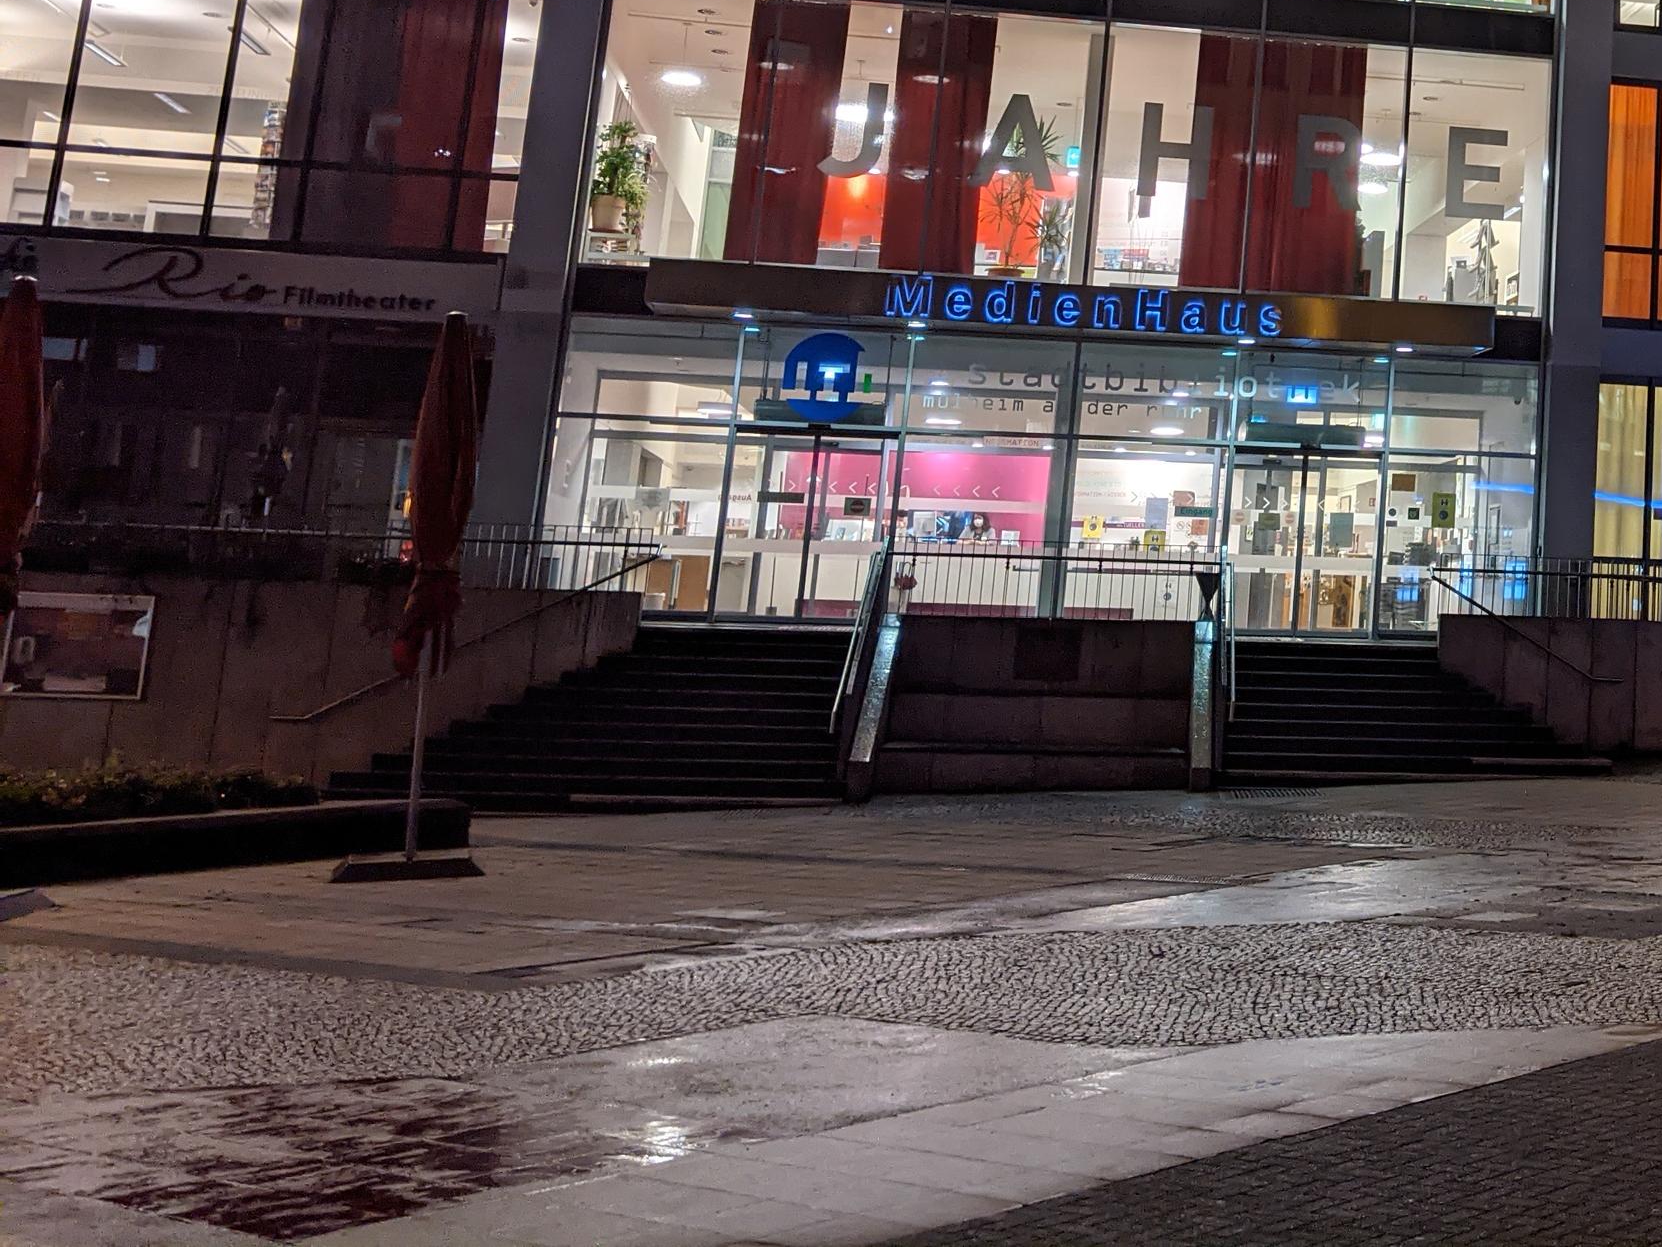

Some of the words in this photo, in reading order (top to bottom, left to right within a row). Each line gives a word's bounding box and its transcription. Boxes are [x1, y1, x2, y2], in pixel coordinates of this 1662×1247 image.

[816, 82, 1509, 220] JAHRE
[66, 246, 277, 302] Rio
[283, 285, 435, 311] Filmtheater
[884, 273, 1282, 337] MedienHaus
[1087, 400, 1128, 416] der
[1146, 404, 1202, 420] rhr
